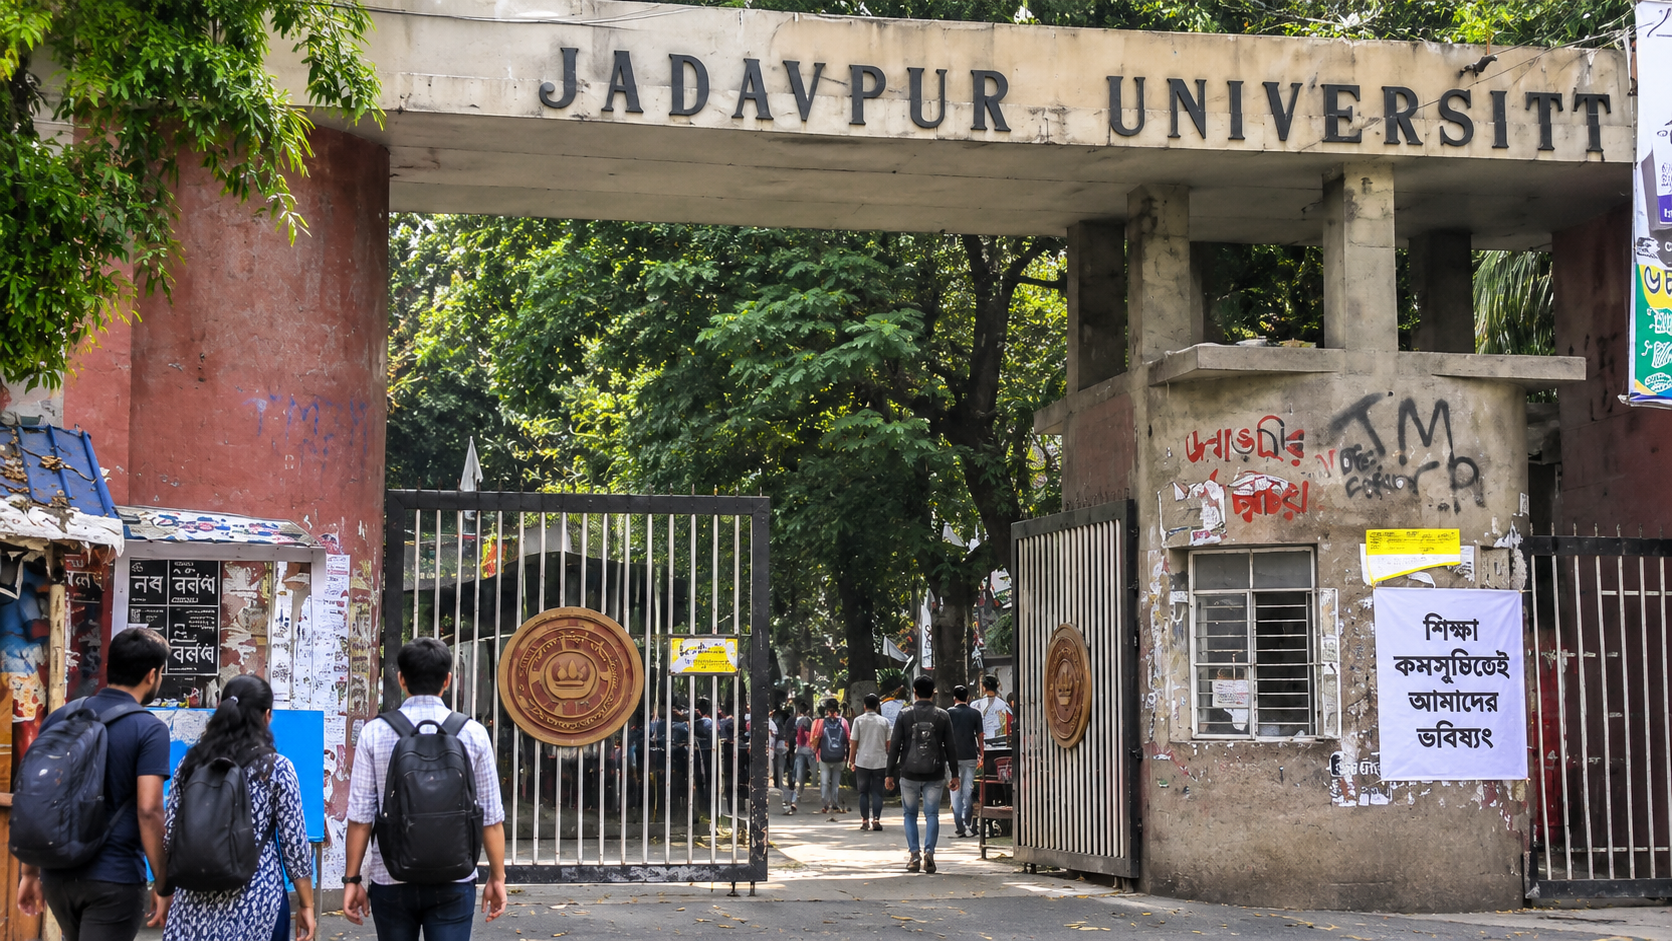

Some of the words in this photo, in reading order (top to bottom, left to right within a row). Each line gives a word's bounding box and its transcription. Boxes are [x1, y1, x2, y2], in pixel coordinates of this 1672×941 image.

[539, 47, 1011, 132] JADAVPUR
[1106, 76, 1611, 153] UNIVERSITT
[1423, 613, 1479, 641] শিক্ষা
[1408, 689, 1499, 712] আমাদের
